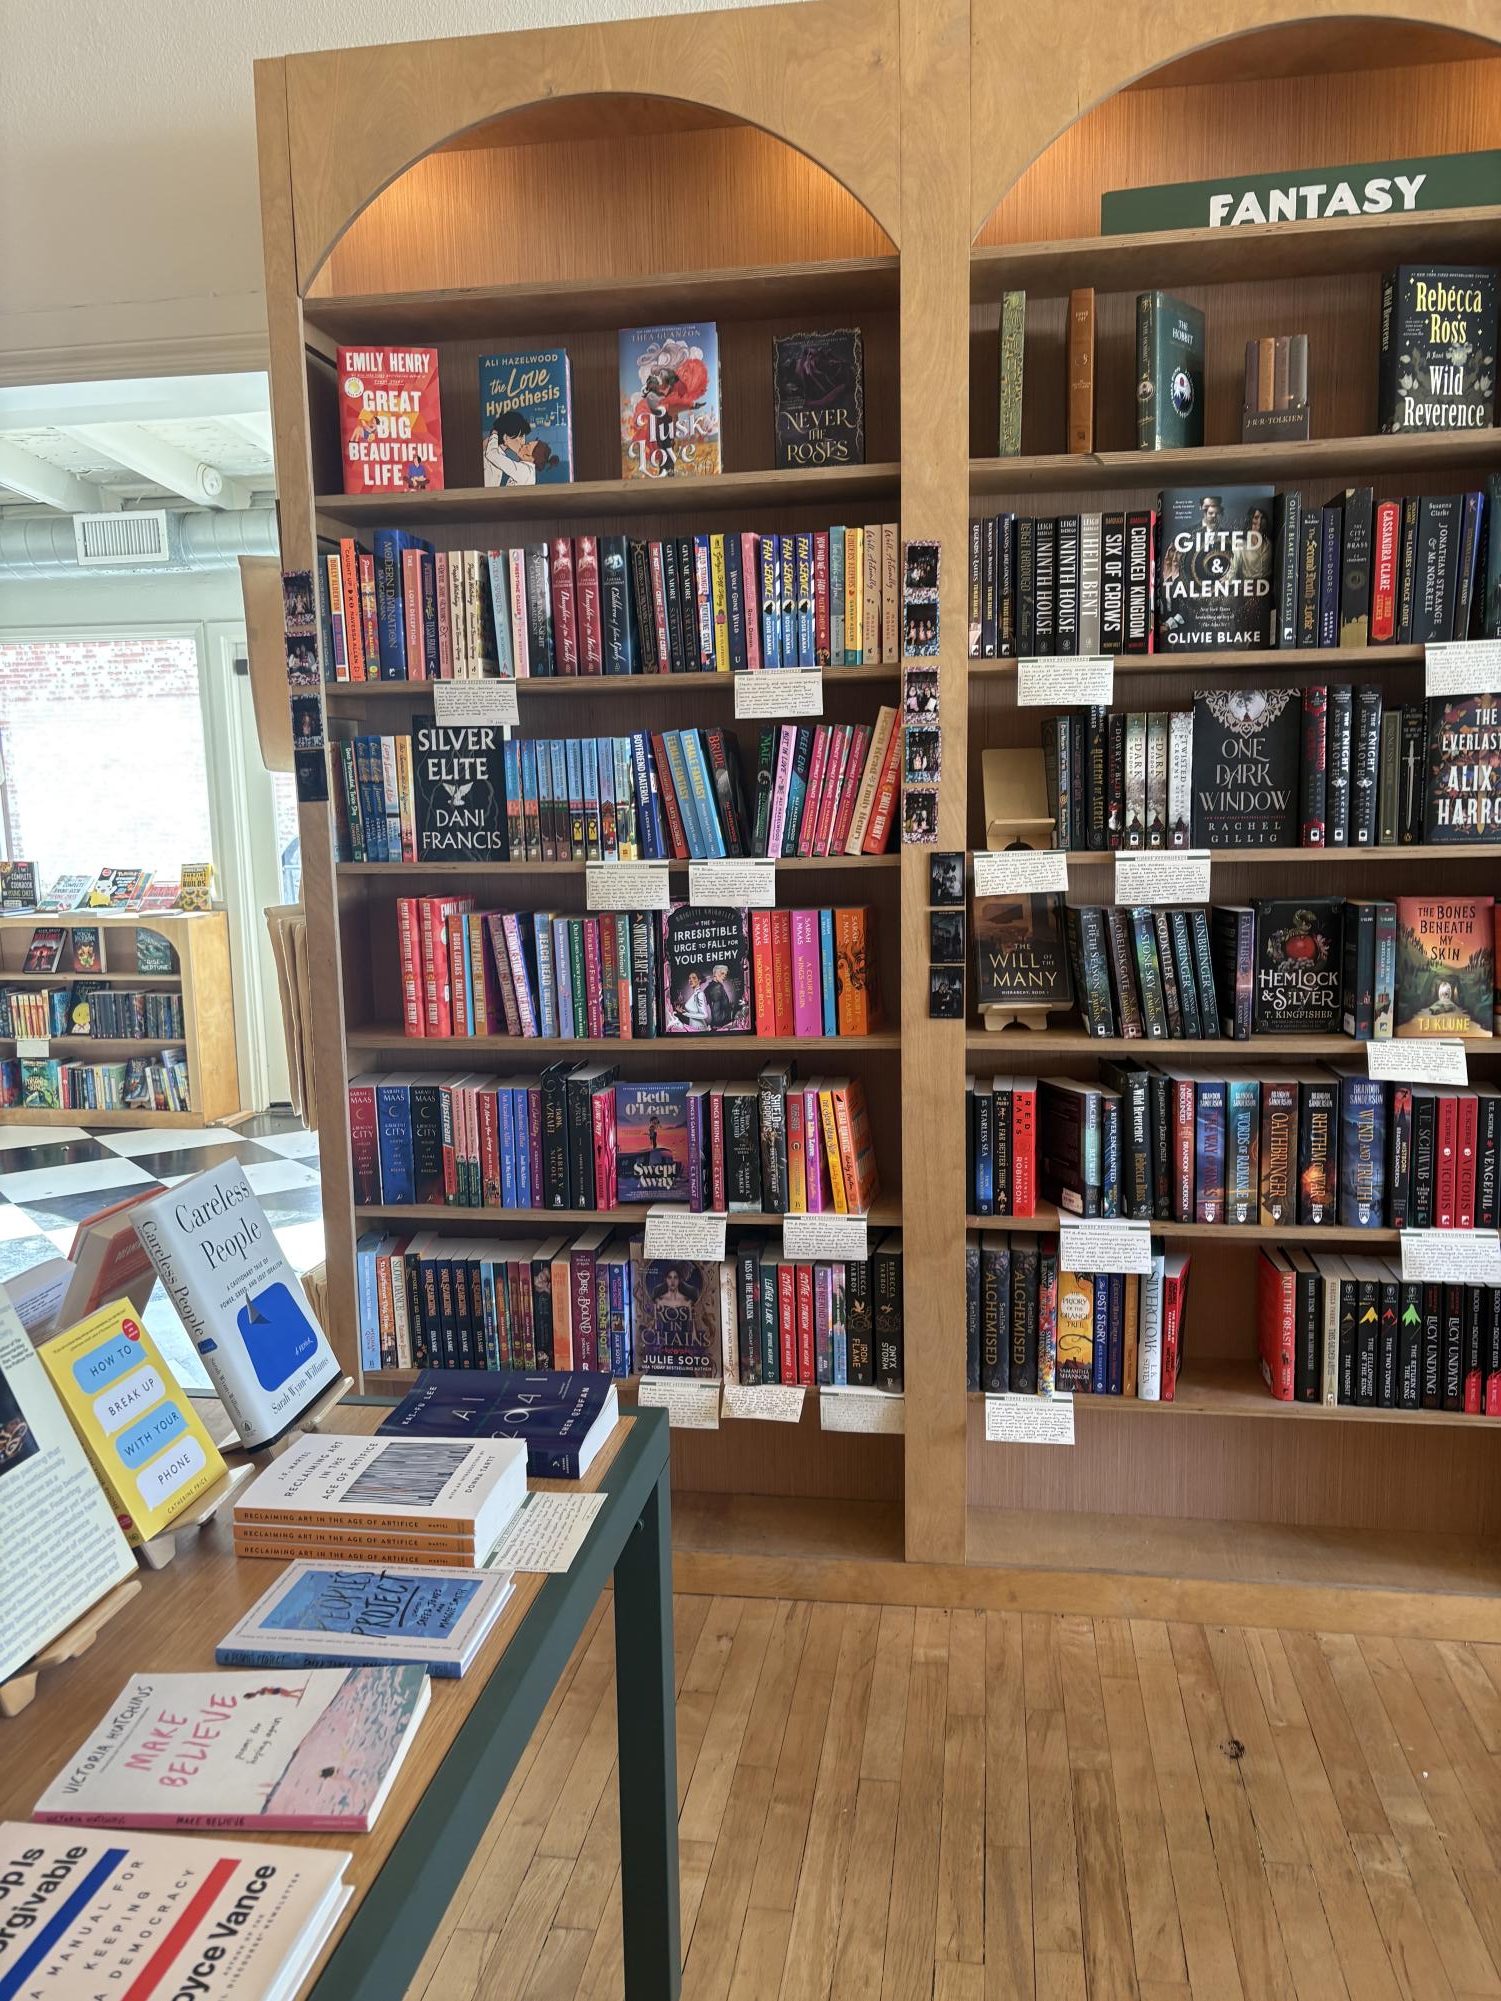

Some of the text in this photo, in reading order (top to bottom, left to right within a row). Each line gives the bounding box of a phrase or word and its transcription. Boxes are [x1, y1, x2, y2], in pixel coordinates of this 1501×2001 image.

[1209, 175, 1426, 228] FANTASY
[1172, 328, 1193, 344] HOBBIT
[1430, 314, 1467, 343] Ross
[346, 352, 430, 373] EMILY HENRY
[485, 354, 558, 368] ALI HAZELWOOD
[490, 368, 550, 396] the Love
[1430, 366, 1463, 395] Wild
[363, 391, 421, 412] GREAT
[486, 385, 559, 419] Hypothesis
[1404, 397, 1484, 426] Reverence
[378, 416, 411, 439] BIG
[636, 406, 713, 443] Tusk
[779, 408, 856, 433] NEVER
[349, 442, 437, 462] BEAUTIFUL
[629, 440, 696, 478] Love
[788, 439, 849, 464] ROSES
[364, 465, 403, 486] LIFE
[1174, 531, 1263, 553] GIFTED
[1380, 510, 1394, 591] CASSANDRA CLARE
[763, 539, 775, 599] FAN SERVICE
[798, 538, 809, 599] FAN SERVICE
[1211, 558, 1224, 573] &
[1433, 523, 1448, 625] JONATHAN STRANGE
[1059, 536, 1076, 633] NINTH HOUSE
[1103, 533, 1122, 632] SIX OF CROWS
[1129, 527, 1146, 638] CROOKED KINGDOM
[1163, 579, 1270, 599] TALENTED
[1168, 631, 1261, 644] OLIVIE BLAKE
[1476, 708, 1498, 725] THE
[417, 728, 496, 751] SILVER
[1222, 738, 1270, 762] ONE
[708, 735, 724, 770] BRIDE
[428, 757, 489, 781] ELITE
[633, 733, 651, 807] BOYFRIEND MATERIAL
[1216, 764, 1274, 789] DARK
[1448, 765, 1492, 791] ALIX
[1200, 790, 1291, 814] WINDOW
[436, 810, 485, 827] DANI
[1208, 822, 1281, 830] RACHEL
[422, 831, 502, 850] FRANCIS
[1211, 834, 1278, 843] GILLIG
[1418, 906, 1476, 919] THE BONES
[674, 926, 738, 942] IRRESISTIBLE
[1420, 920, 1473, 934] BENEATH
[633, 923, 649, 973] SWORDHEART
[674, 943, 697, 953] URGE
[707, 940, 727, 950] FALL
[1175, 915, 1189, 989] SUNBRINGER
[1430, 946, 1460, 961] SKIN
[1440, 937, 1453, 946] MY
[675, 950, 738, 966] YOUR ENEMY
[989, 953, 1040, 969] WILL
[1087, 924, 1100, 990] FIFTH SEASON
[993, 971, 1058, 988] MANY
[1258, 969, 1339, 991] HEMLOCK
[1277, 1010, 1333, 1019] KINGFISHER
[1418, 1017, 1470, 1031] TJ KLUNE
[384, 1094, 405, 1102] MAAS
[636, 1090, 670, 1103] Beth
[1015, 1094, 1024, 1136] MARS
[385, 1128, 406, 1136] CITY
[1269, 1112, 1289, 1198] OATHBRINGER
[633, 1162, 677, 1178] Swept
[1015, 1156, 1023, 1204] ROBINSON
[637, 1176, 675, 1190] Away
[175, 1180, 250, 1234] Careless
[200, 1217, 262, 1270] People
[142, 1220, 205, 1336] Careless People
[1013, 1272, 1025, 1364] ALCHEMISED
[641, 1330, 712, 1348] CHAINS
[90, 1344, 132, 1377] HOW TO
[643, 1355, 710, 1366] JULIE SOTO
[1426, 1344, 1438, 1395] UNDYING
[108, 1378, 156, 1417] BREAK UP
[424, 1386, 437, 1400] LEE
[452, 1398, 485, 1422] AI
[124, 1411, 180, 1457] WITH YOUR
[157, 1454, 192, 1485] PHONE
[284, 1440, 344, 1497] RECLAIMING ART
[322, 1442, 379, 1500] AGE OF ARTIFICE
[465, 1472, 484, 1494] DONNA
[167, 1486, 195, 1514] CATHERINE
[244, 1512, 419, 1529] RECLAIMING ART THE AGE OF ARTIFICE
[350, 1569, 416, 1639] PROJECT
[62, 1685, 154, 1794] VICTORIA HUTCHINS
[123, 1710, 189, 1772] MAKE
[159, 1693, 238, 1788] BELIEVE
[177, 1816, 245, 1827] MAKE BELIEVE
[9, 1848, 45, 1868] Is
[207, 1865, 277, 1940] Vance
[46, 1861, 144, 1976] MANUAL FOR
[83, 1892, 150, 1970] KEEPING
[109, 1869, 195, 1979] DEMOCRACY
